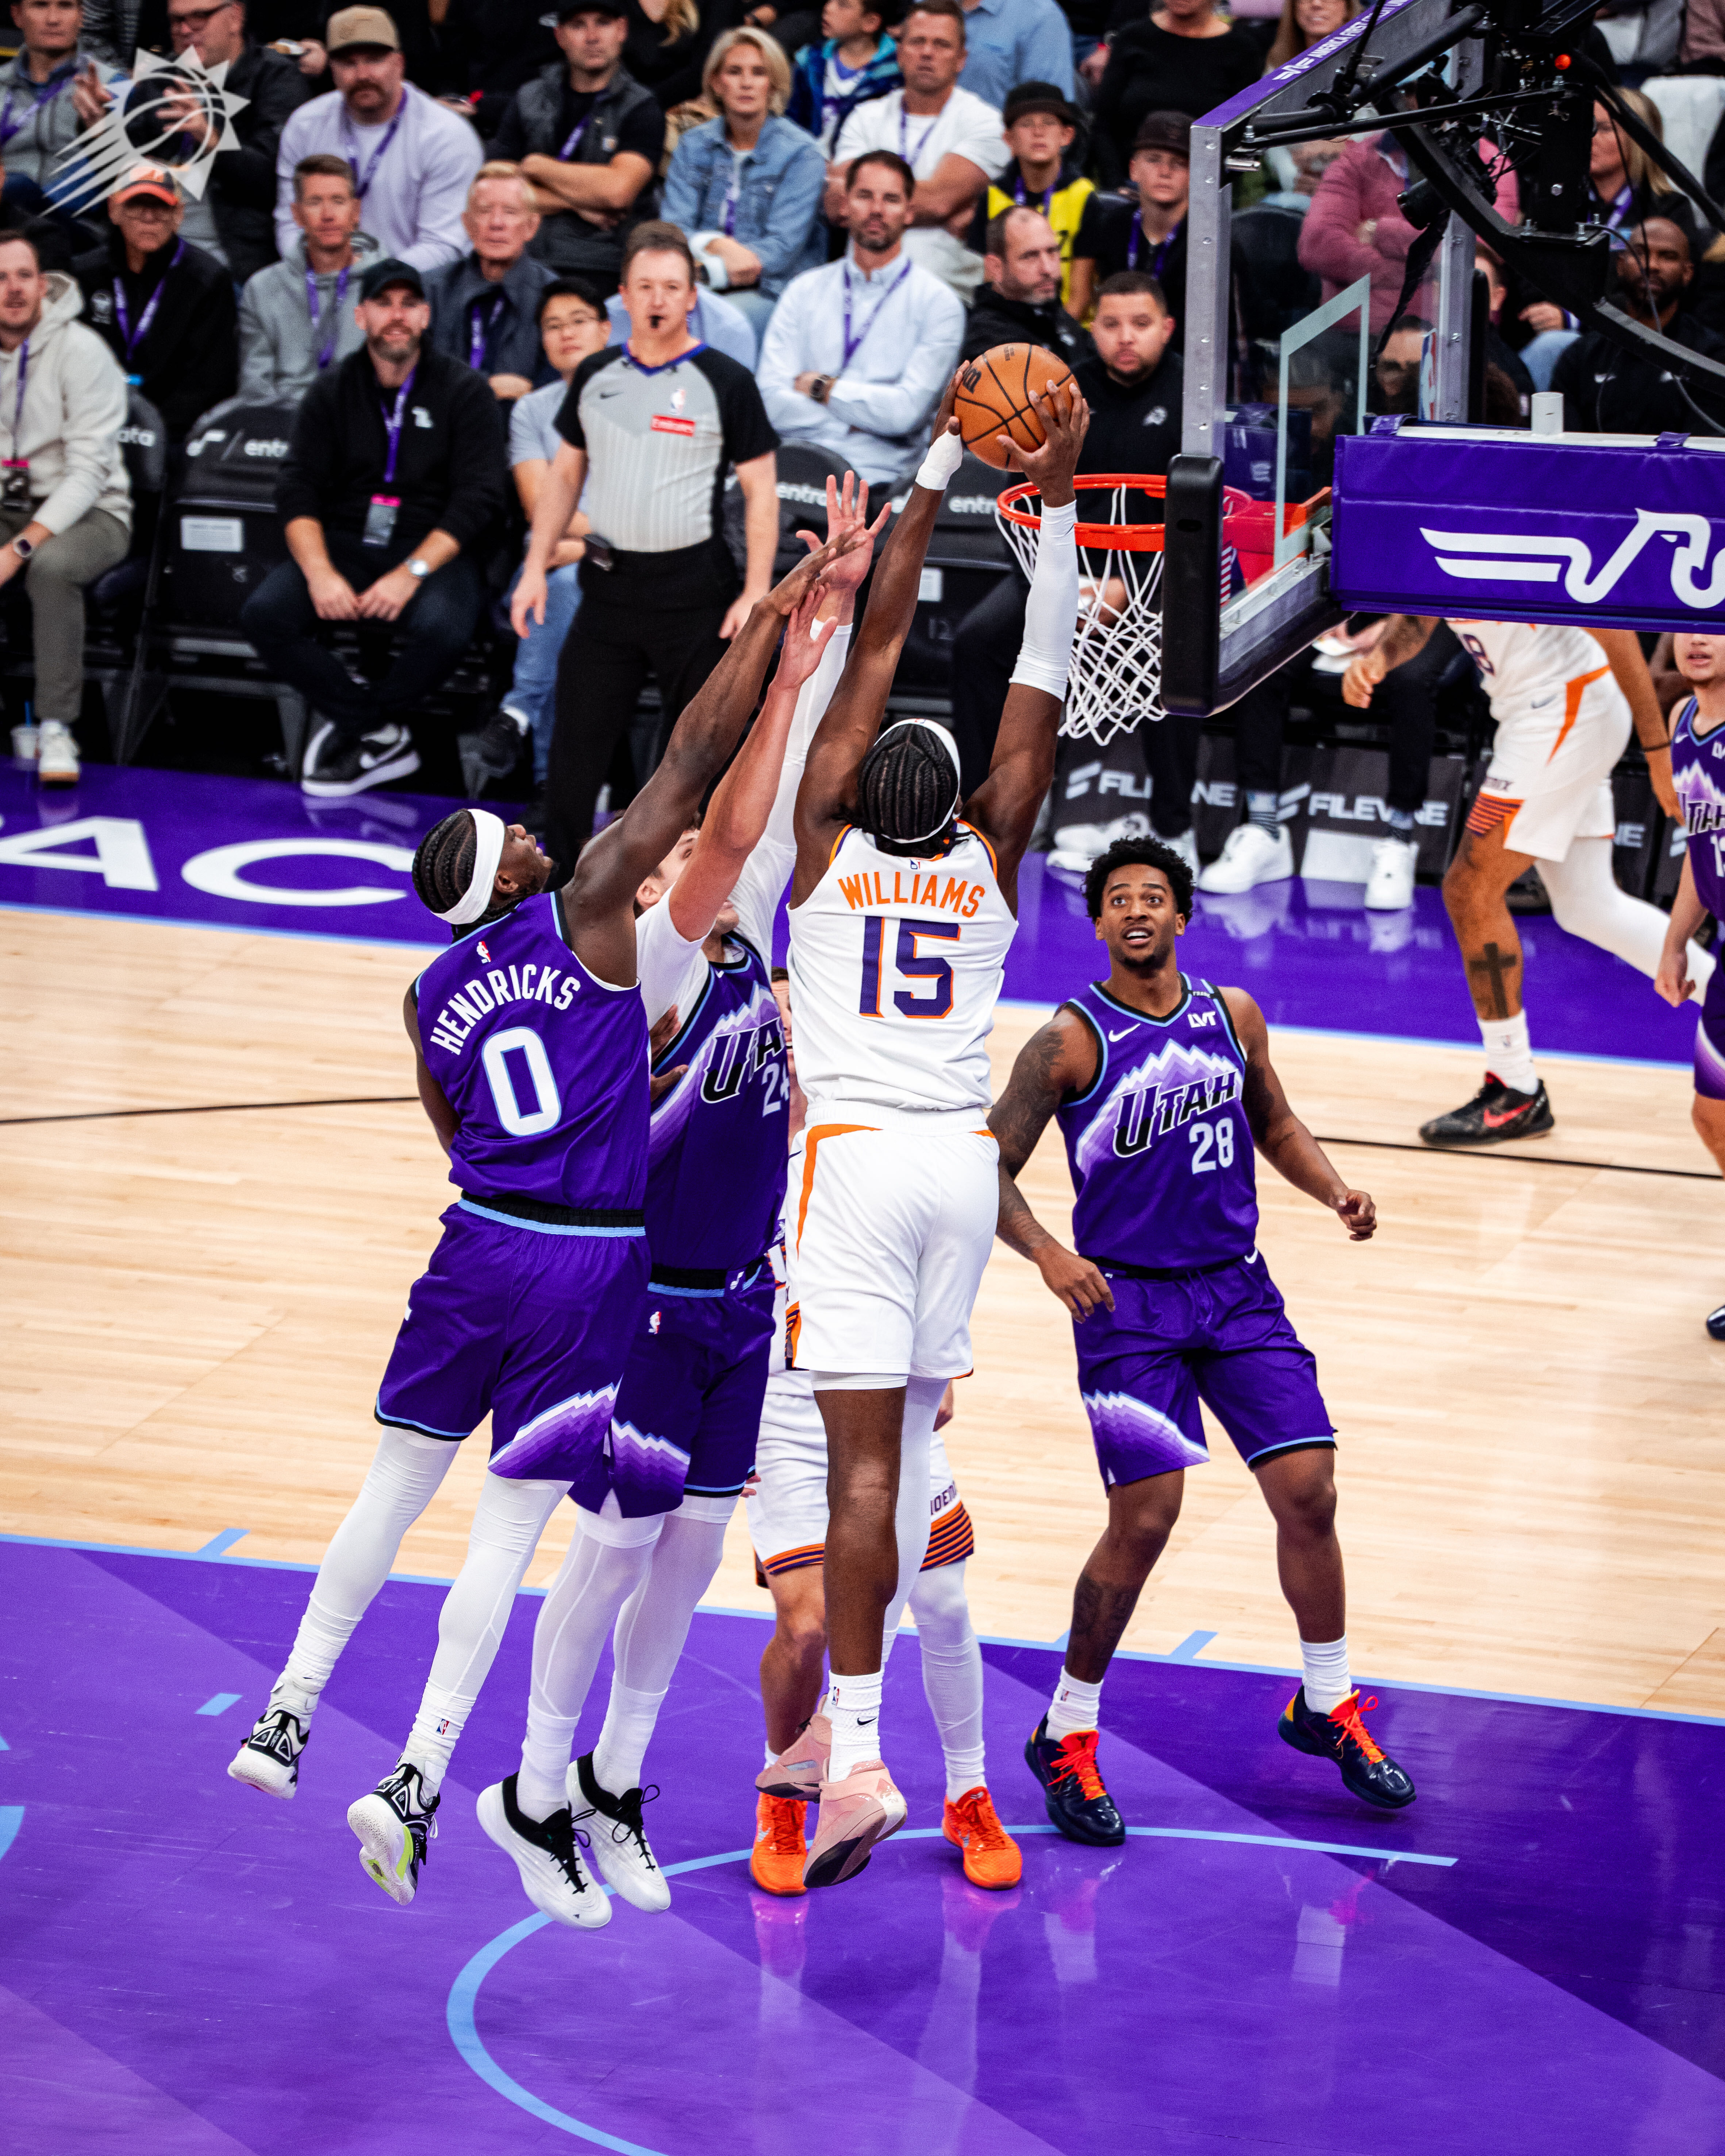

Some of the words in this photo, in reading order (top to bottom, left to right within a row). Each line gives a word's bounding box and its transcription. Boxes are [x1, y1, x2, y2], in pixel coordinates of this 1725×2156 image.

[1307, 36, 1353, 58] AMERICA
[1339, 22, 1367, 36] FIRST
[837, 871, 985, 918] WILLIAMS
[859, 916, 961, 1019] 15
[430, 964, 581, 1056] HENDRICKS
[1187, 1011, 1216, 1028] LVT
[481, 1026, 562, 1137] 0
[1188, 1117, 1234, 1175] 28
